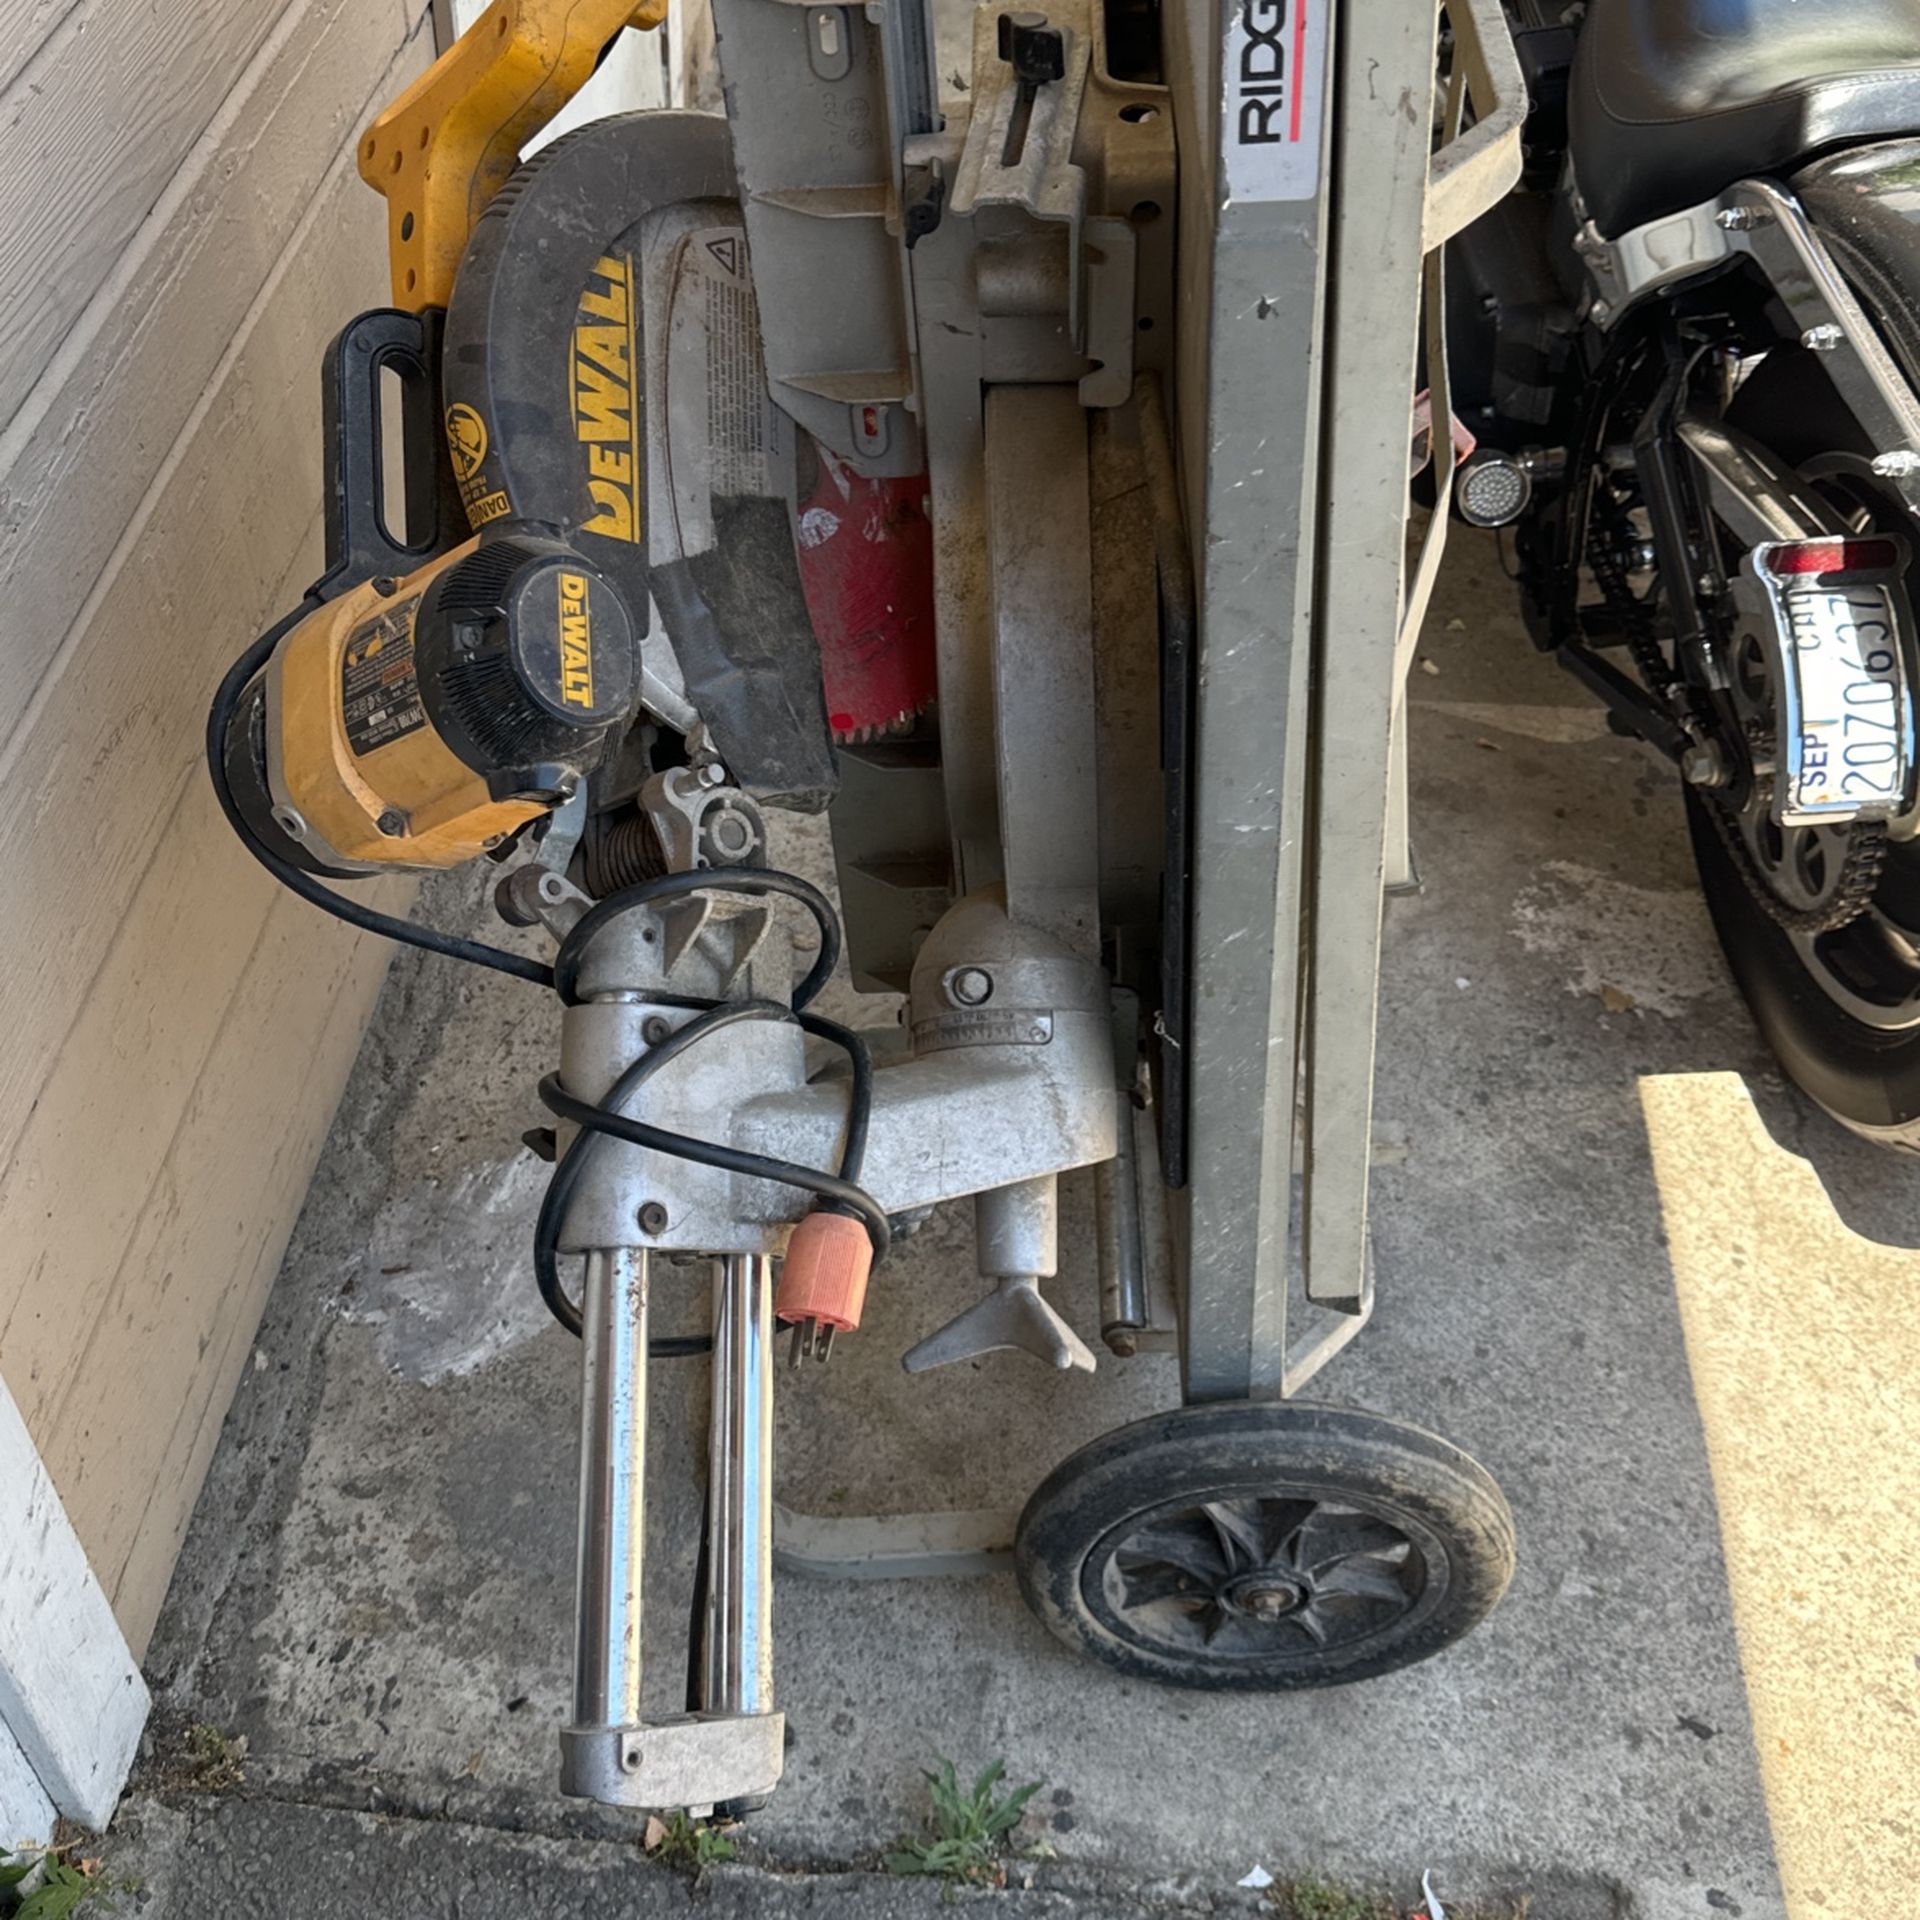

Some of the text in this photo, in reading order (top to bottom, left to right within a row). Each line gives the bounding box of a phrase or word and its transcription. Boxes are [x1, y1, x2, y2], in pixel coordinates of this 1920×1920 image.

[1238, 0, 1287, 145] RIDG
[561, 574, 593, 708] DEWALT
[1801, 733, 1829, 787] SEP
